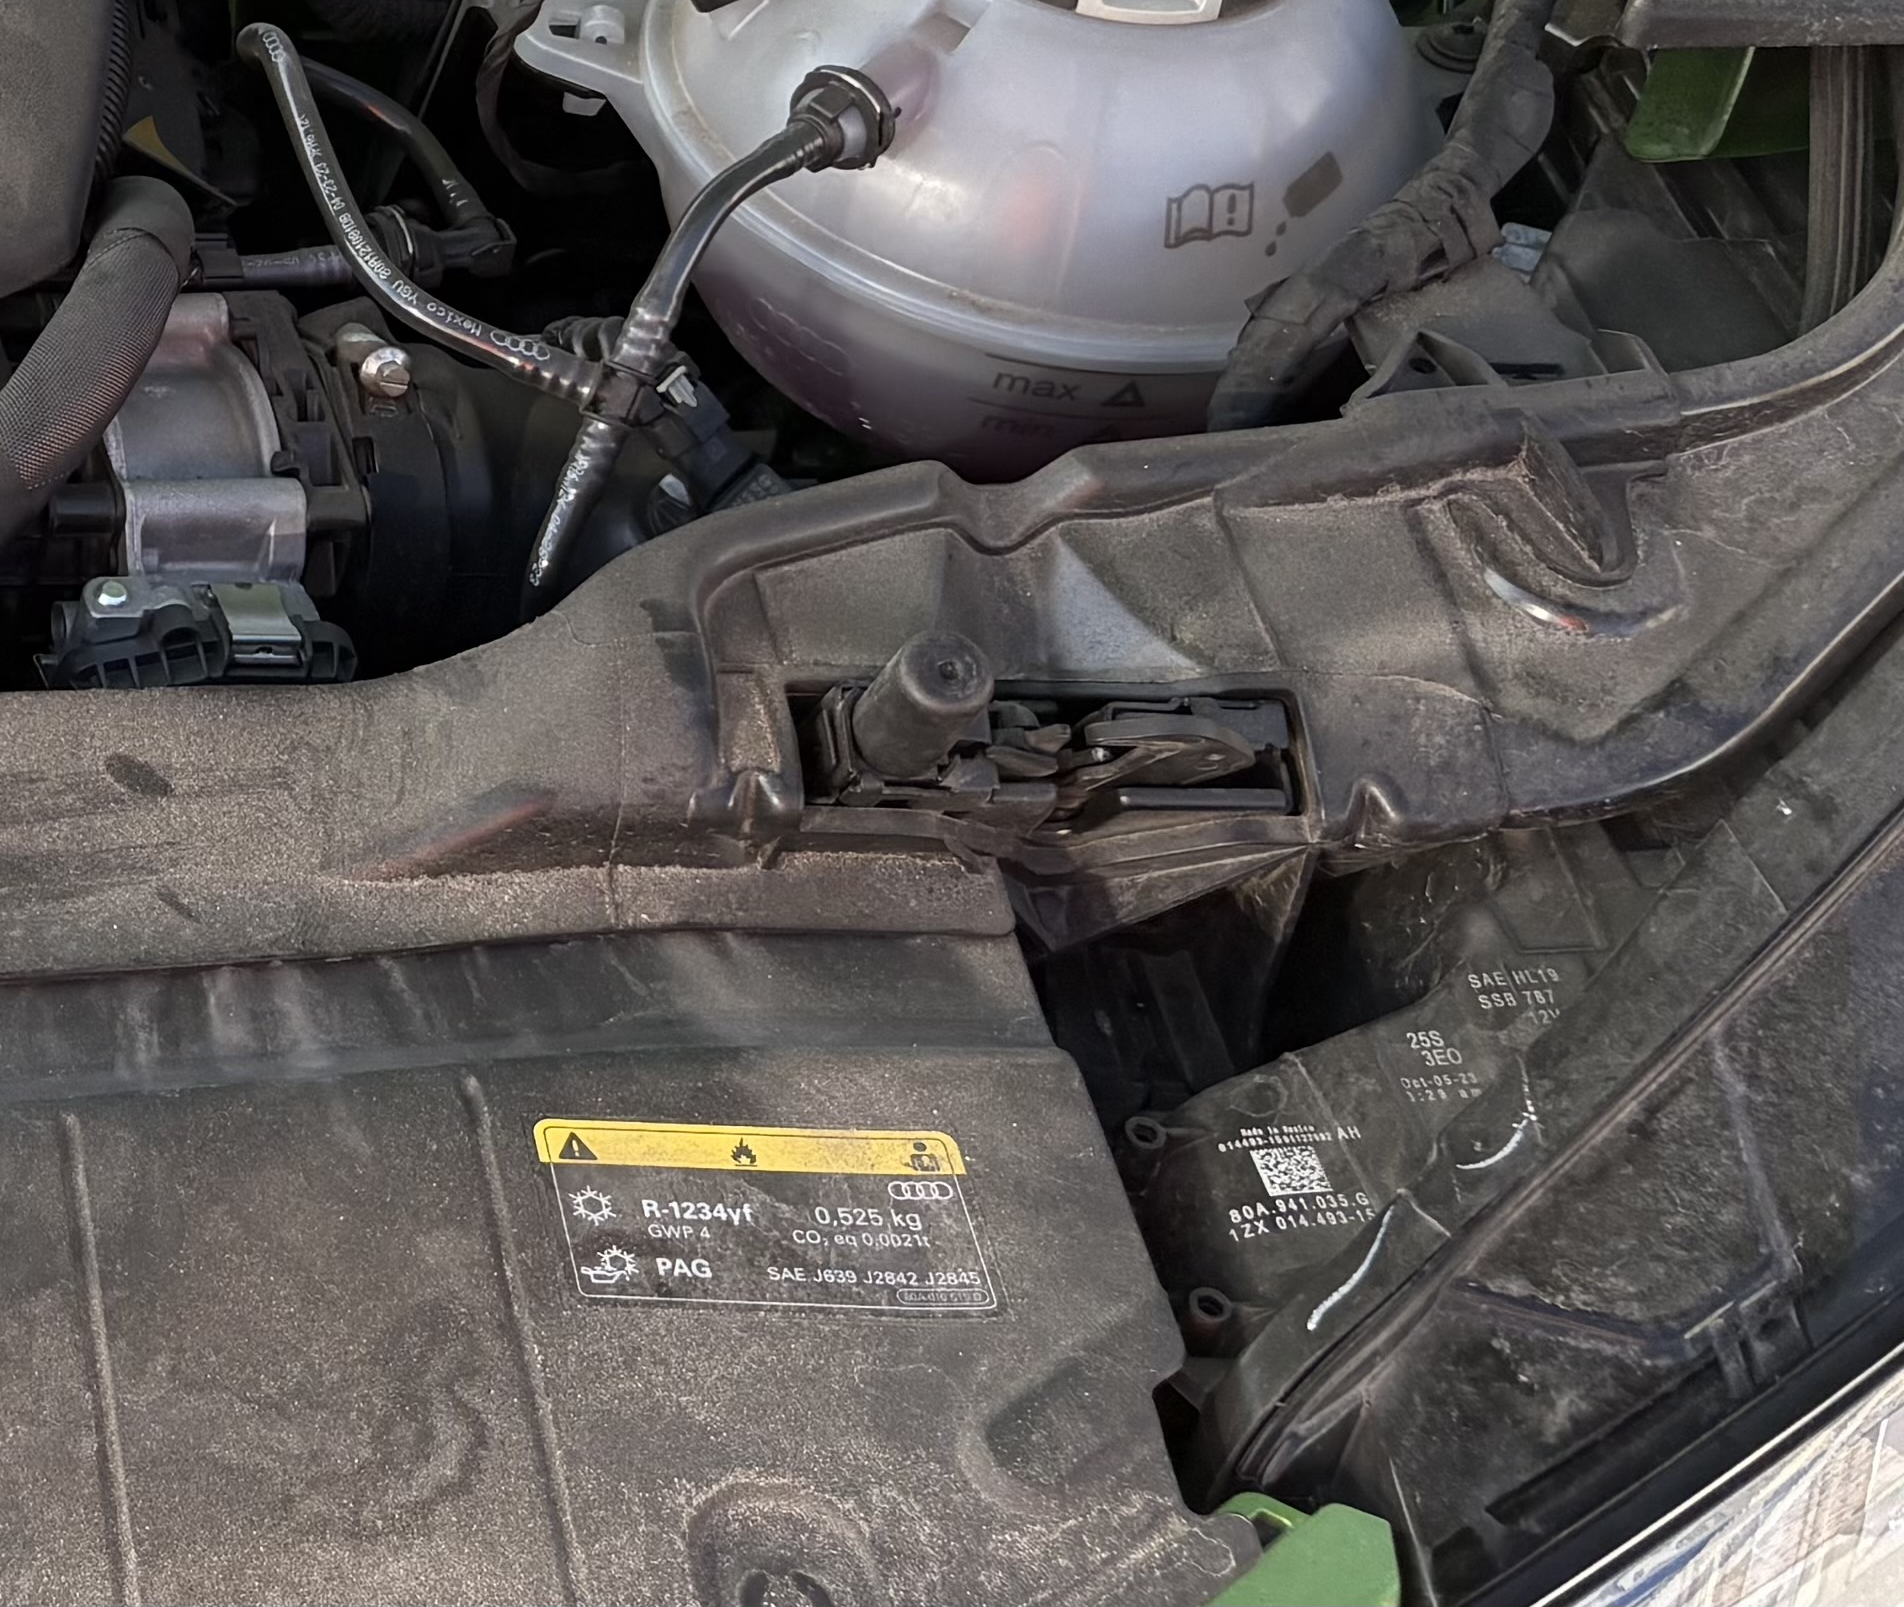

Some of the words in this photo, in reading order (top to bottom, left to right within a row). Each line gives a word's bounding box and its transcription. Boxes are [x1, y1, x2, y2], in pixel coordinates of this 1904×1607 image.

[426, 301, 482, 337] Mexico
[992, 372, 1081, 401] max
[1468, 971, 1508, 989] SAE
[1478, 992, 1517, 1009] SSB
[1406, 1030, 1445, 1049] 25S
[1337, 1125, 1362, 1140] AH
[642, 1199, 753, 1225] R-1234yf
[813, 1207, 885, 1228] 0,525
[891, 1210, 922, 1231] kg
[1229, 1192, 1370, 1223] 80A.941.035.G
[647, 1224, 693, 1239] GWP
[700, 1227, 711, 1238] 4
[834, 1233, 857, 1248] eq
[1229, 1219, 1270, 1242] 1ZX
[655, 1257, 713, 1278] PAG
[766, 1266, 807, 1282] SAE
[813, 1269, 858, 1284] J639
[863, 1271, 919, 1286] J2842
[925, 1271, 981, 1286] J2845
